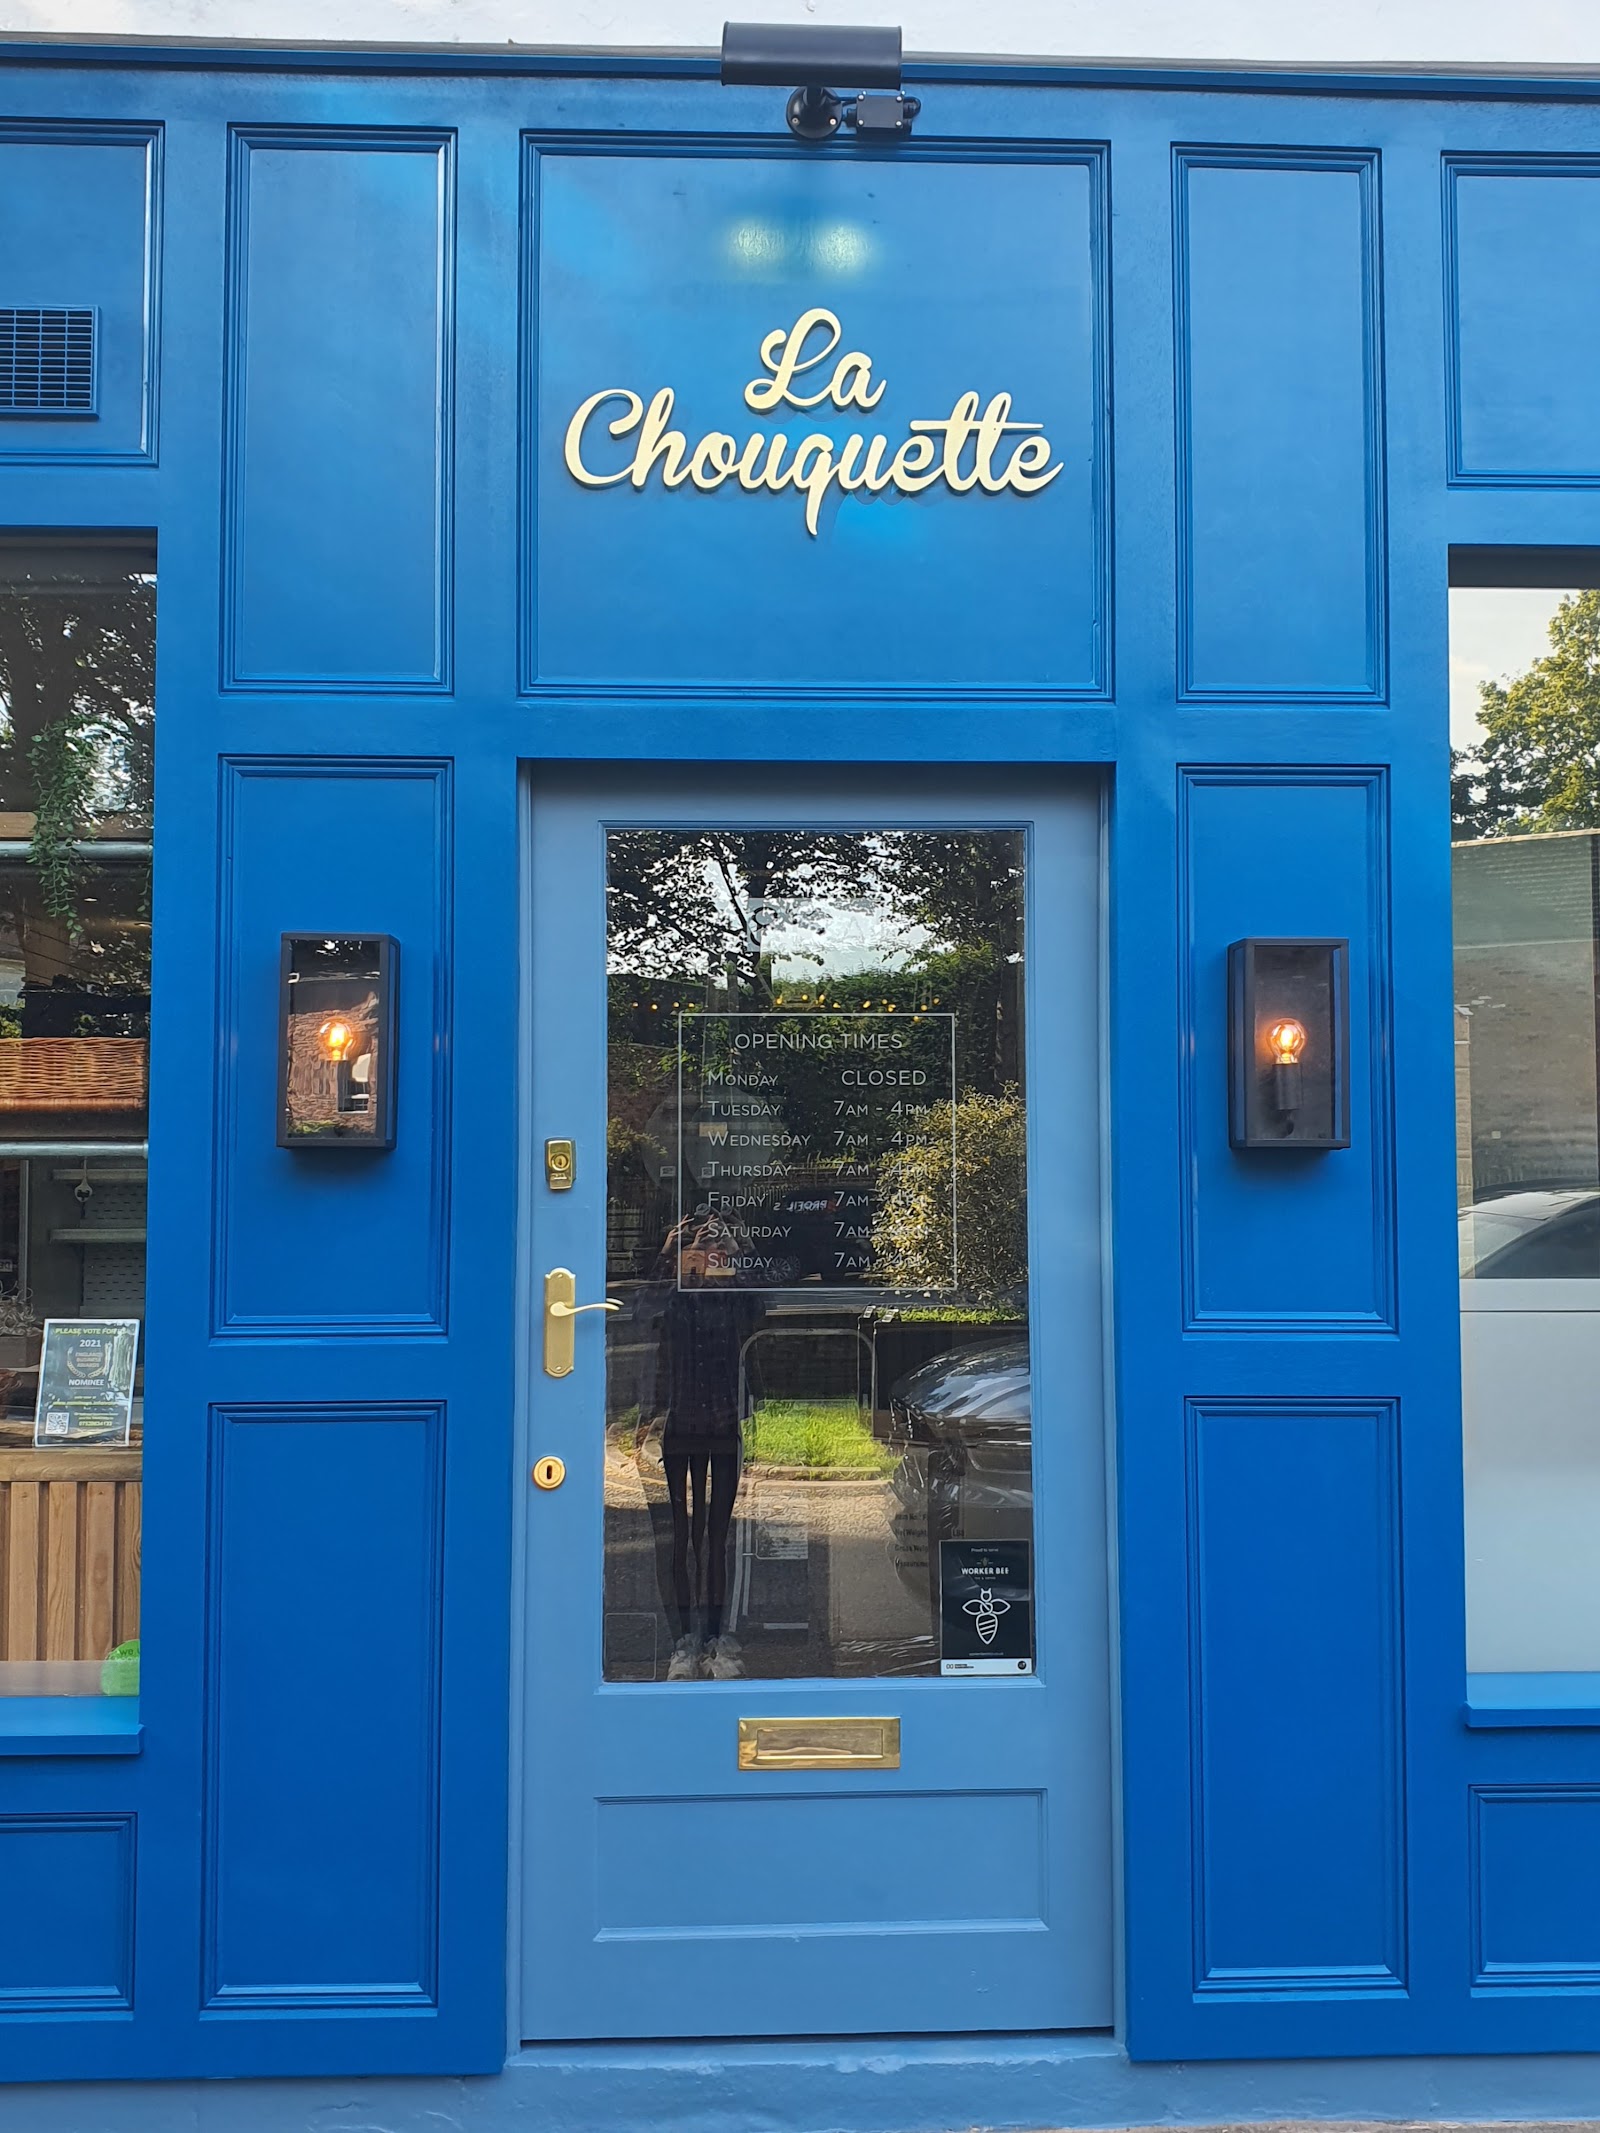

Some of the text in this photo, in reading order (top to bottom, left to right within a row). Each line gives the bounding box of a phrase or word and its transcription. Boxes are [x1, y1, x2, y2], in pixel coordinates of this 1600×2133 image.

[744, 307, 886, 411] La
[563, 387, 1065, 537] Chouquette
[734, 1033, 903, 1050] OPENING TIMES
[707, 1070, 927, 1087] MONDAY CLOSED
[707, 1100, 781, 1116] TUESDAY
[834, 1100, 869, 1116] 7AM
[890, 1100, 928, 1116] 4PM
[707, 1131, 811, 1147] WEDNESDAY
[834, 1131, 869, 1146] 7AM
[890, 1130, 928, 1146] 4PM
[707, 1161, 792, 1177] THURSDAY
[834, 1161, 870, 1177] 7AM
[707, 1191, 766, 1208] FRIDAY
[834, 1191, 869, 1207] 7AM
[706, 1221, 870, 1238] SATURDAY 7AM
[706, 1252, 773, 1269] SUNDAY
[834, 1252, 871, 1268] 7AM
[83, 1327, 101, 1335] VOTE
[79, 1339, 102, 1348] 2021
[68, 1379, 105, 1387] NOMINEE
[961, 1567, 994, 1575] WORKER
